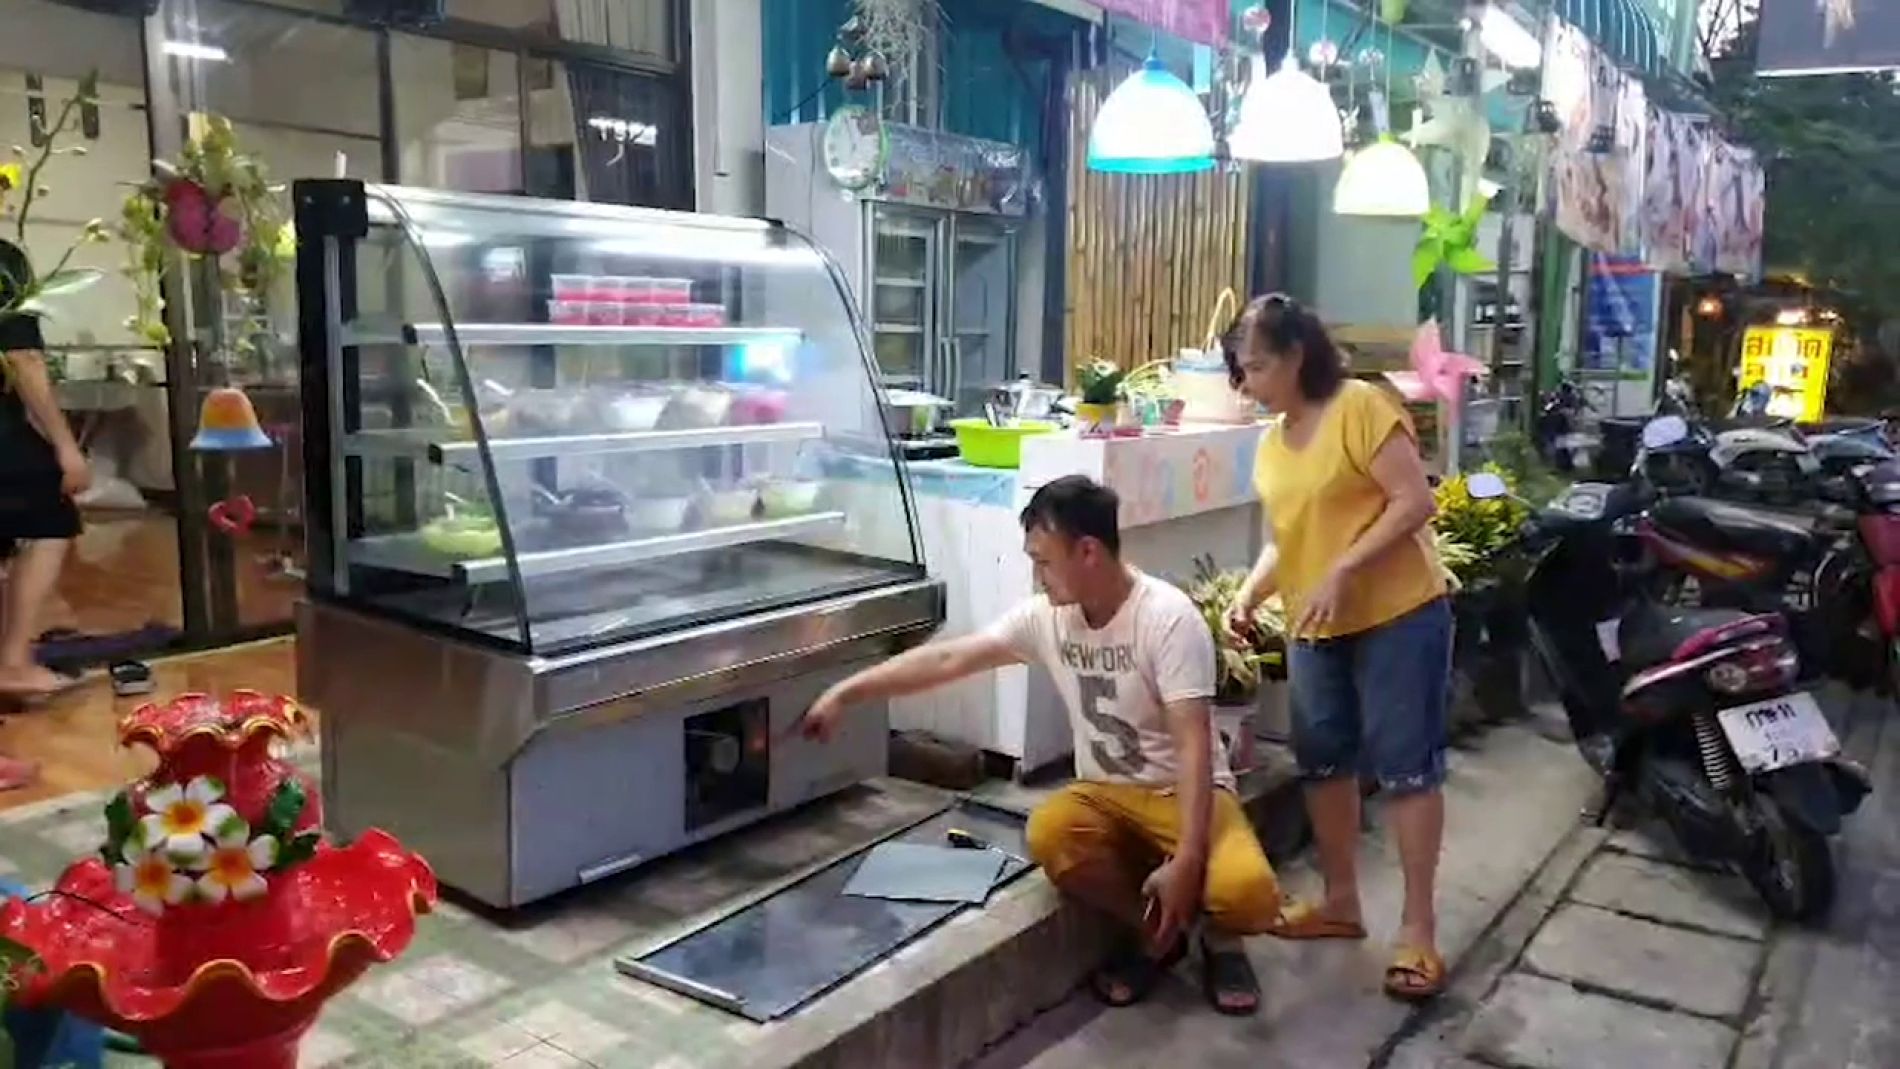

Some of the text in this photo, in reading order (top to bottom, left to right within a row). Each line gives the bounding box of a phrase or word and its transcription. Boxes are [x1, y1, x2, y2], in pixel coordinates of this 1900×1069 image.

[1061, 643, 1138, 673] NEW ORK
[1077, 676, 1143, 776] 5
